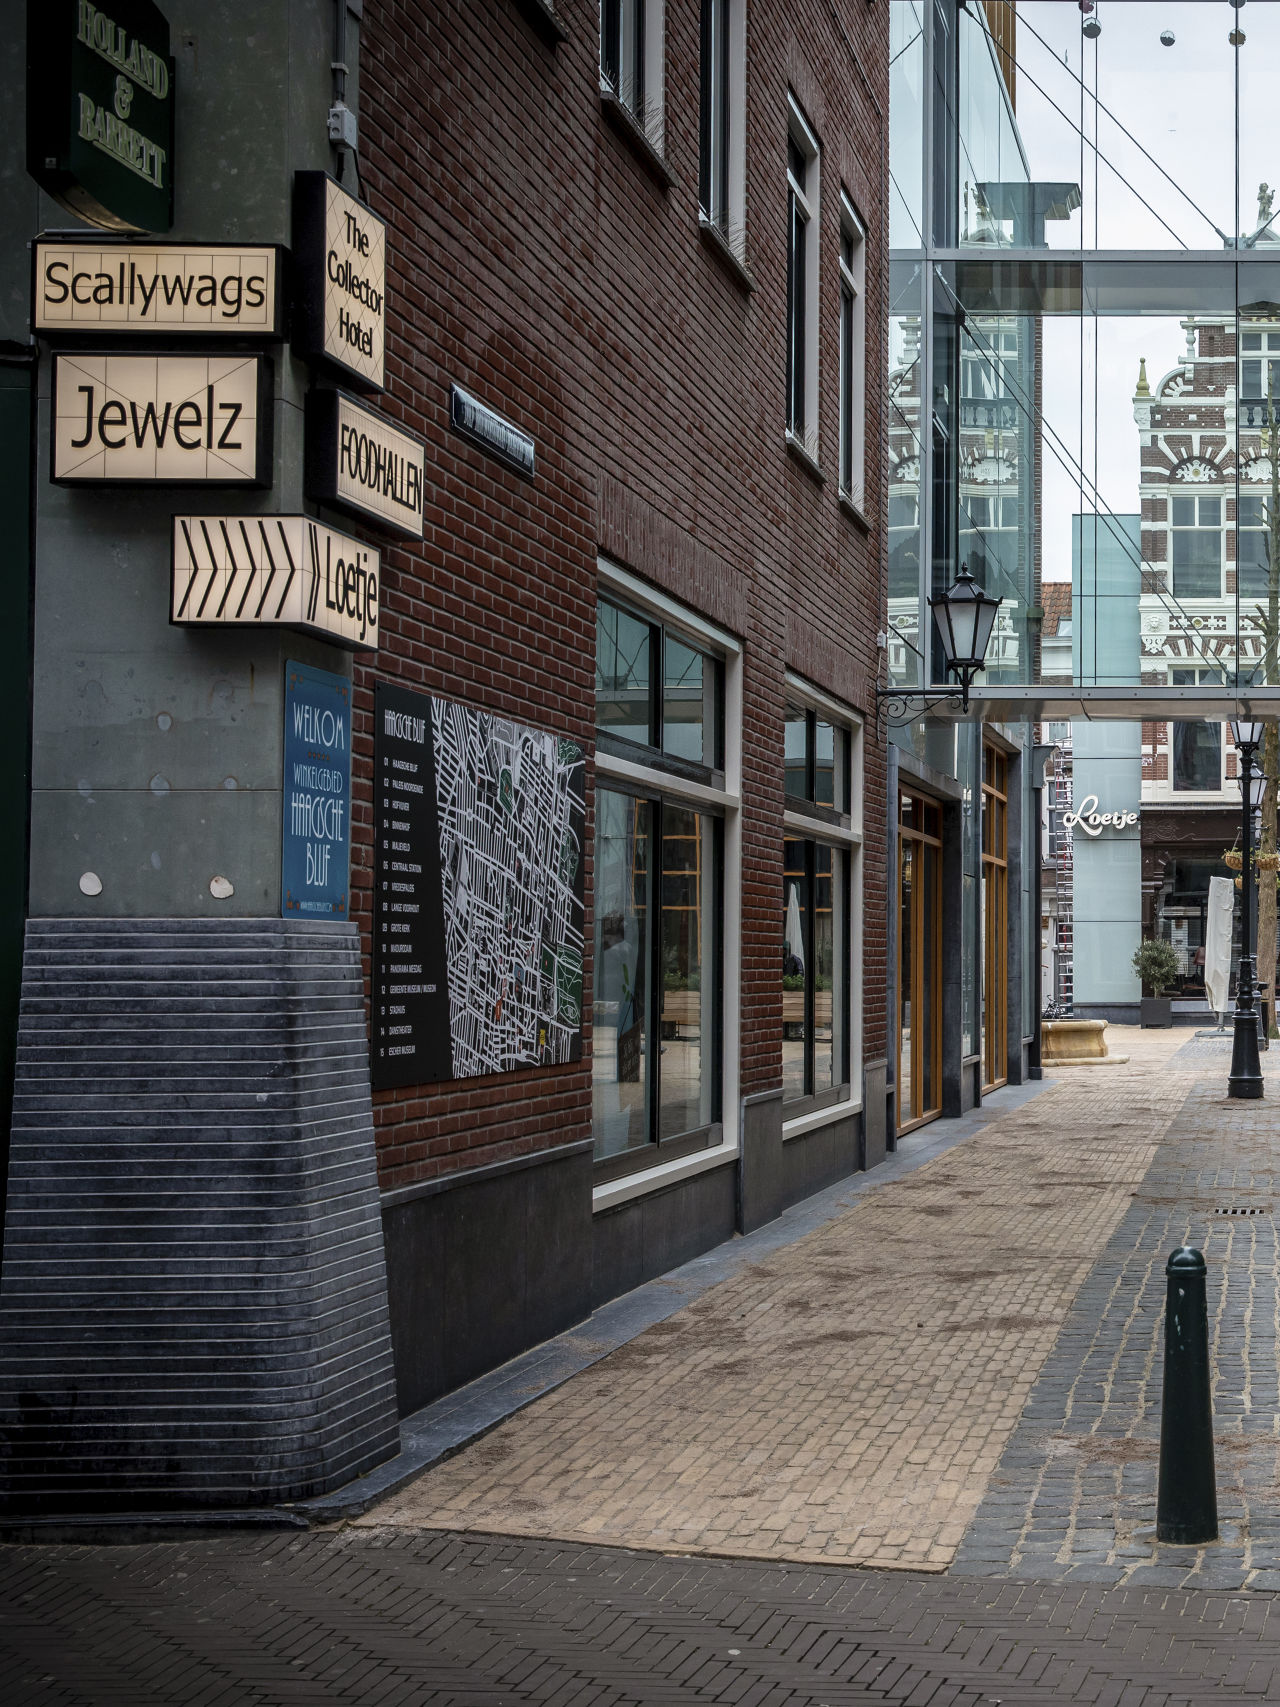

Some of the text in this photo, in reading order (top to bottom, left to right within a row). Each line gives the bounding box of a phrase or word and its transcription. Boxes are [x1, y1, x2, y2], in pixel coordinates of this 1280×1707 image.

[77, 0, 168, 99] HOLLAND
[114, 74, 134, 119] &
[78, 93, 166, 189] BARRETT
[344, 211, 369, 258] The
[45, 261, 265, 318] Scallywags
[327, 250, 384, 316] Collector
[339, 308, 373, 358] Hotel
[71, 384, 243, 450] Jewelz
[340, 424, 423, 514] FOODHALLEN
[326, 536, 378, 641] Loetje
[294, 702, 345, 750] WELKOM
[294, 762, 343, 793] WINKELGEBIED
[291, 792, 344, 841] HAAGSCHE
[1062, 794, 1138, 837] Loetje
[306, 843, 331, 886] BLUF
